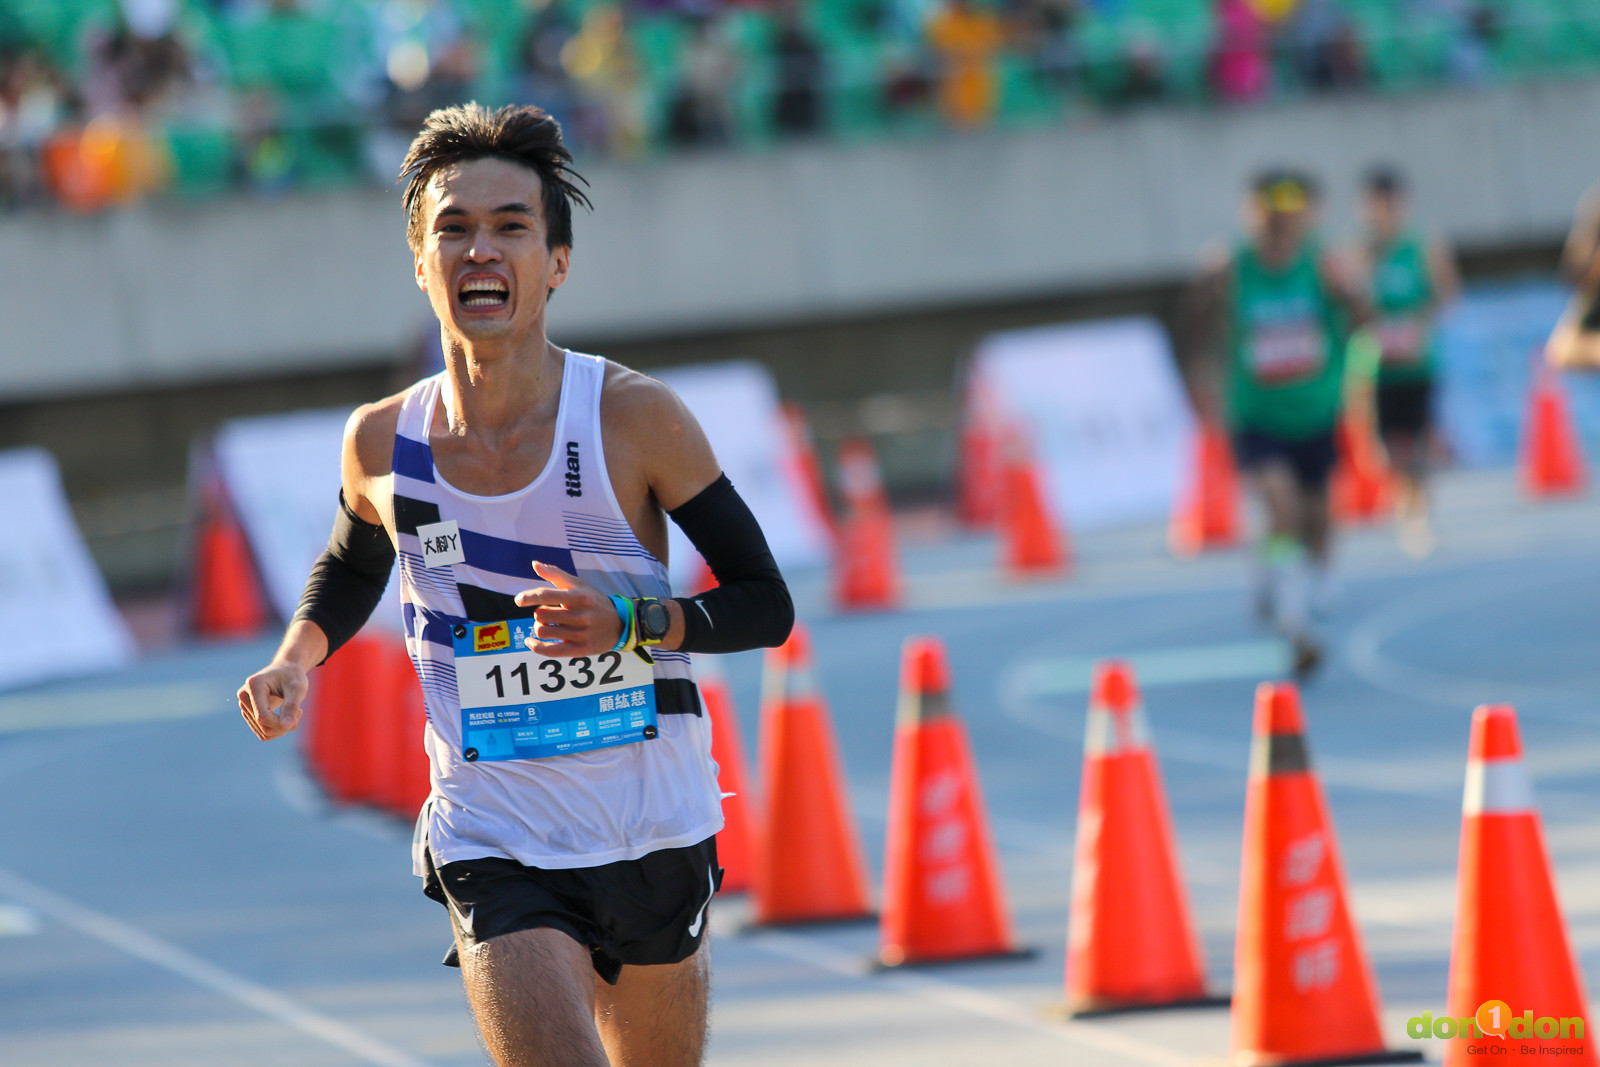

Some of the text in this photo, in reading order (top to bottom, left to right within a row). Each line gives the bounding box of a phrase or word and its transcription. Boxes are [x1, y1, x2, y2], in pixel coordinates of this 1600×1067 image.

[565, 441, 582, 498] titan
[486, 651, 624, 698] 11332
[528, 707, 536, 716] B
